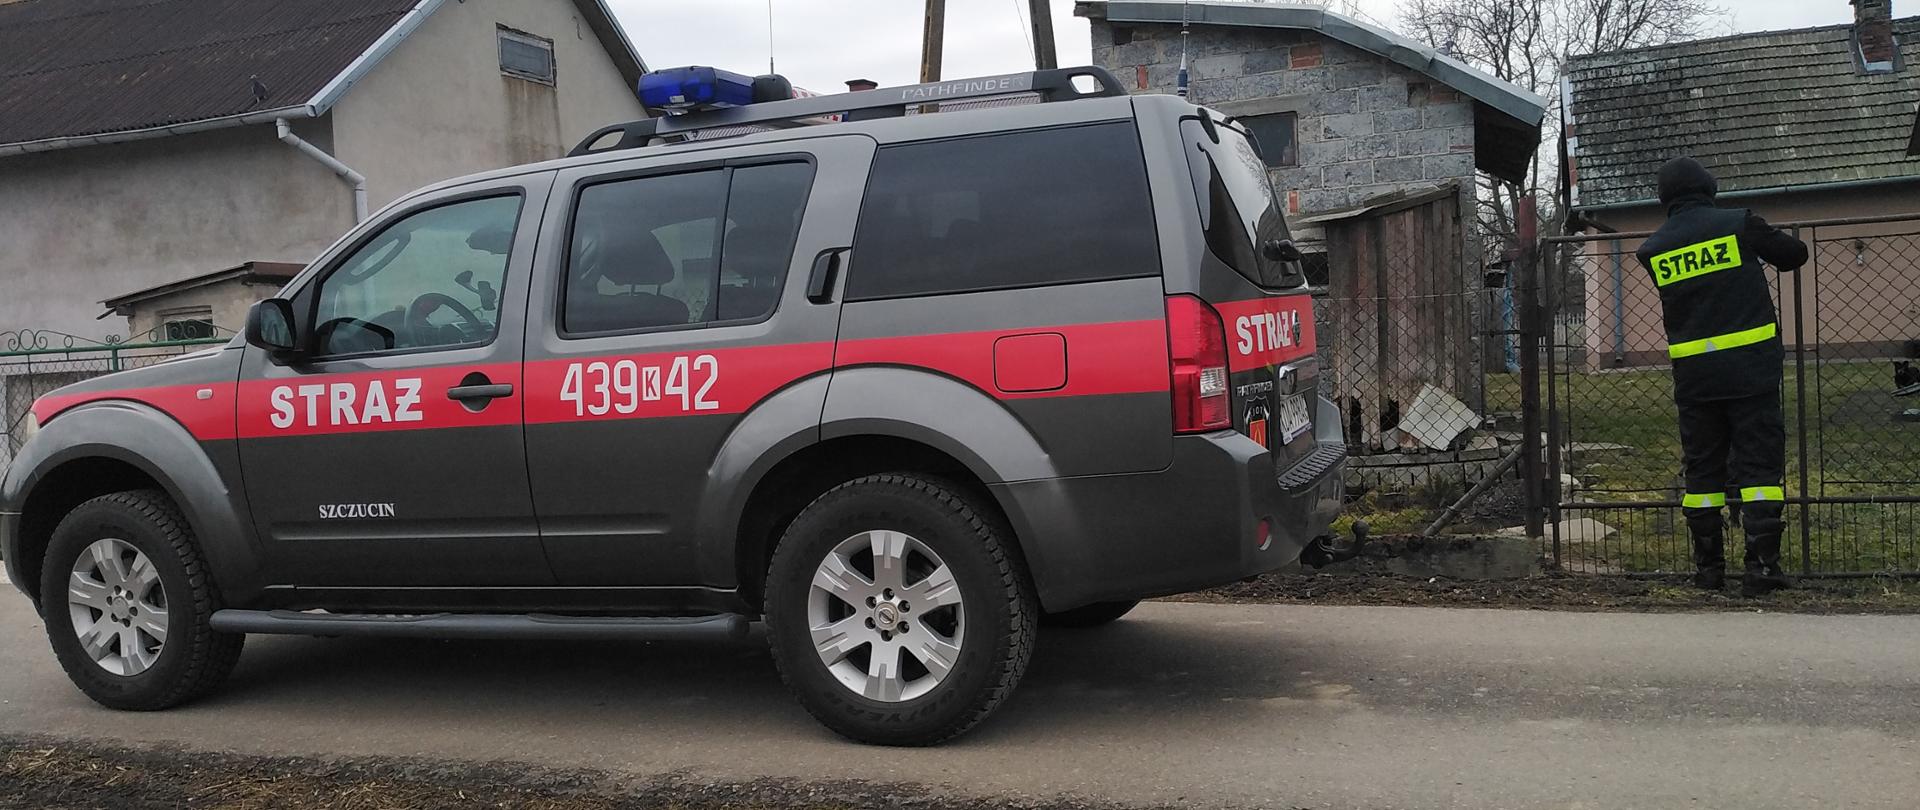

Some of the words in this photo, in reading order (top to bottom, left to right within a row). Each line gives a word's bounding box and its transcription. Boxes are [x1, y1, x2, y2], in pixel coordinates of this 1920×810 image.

[901, 76, 1025, 100] PATHFINDER
[1658, 243, 1731, 280] STRAŻ
[1236, 310, 1291, 355] STRAŻ
[270, 378, 423, 429] STRAŻ
[319, 503, 395, 519] SZCZUCIN
